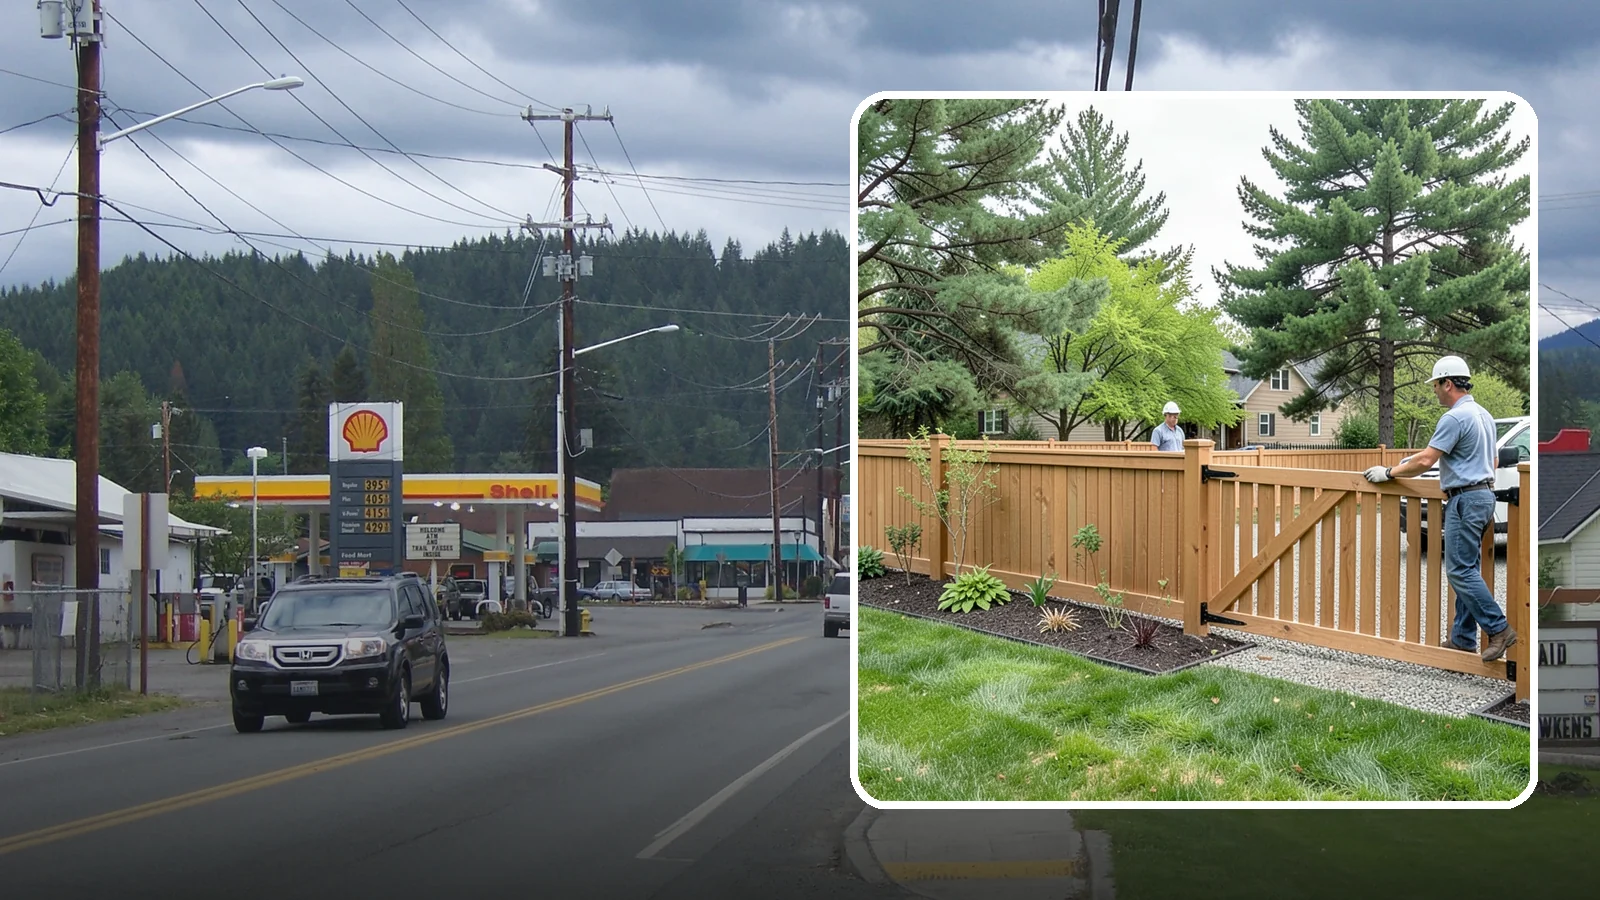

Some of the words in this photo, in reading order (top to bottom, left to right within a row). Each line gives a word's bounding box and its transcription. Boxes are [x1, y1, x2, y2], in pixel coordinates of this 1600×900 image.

[365, 480, 384, 490] 395
[490, 484, 548, 498] Shell
[365, 494, 384, 504] 405
[365, 508, 384, 518] 415
[365, 522, 384, 533] 429
[1538, 643, 1567, 666] AID
